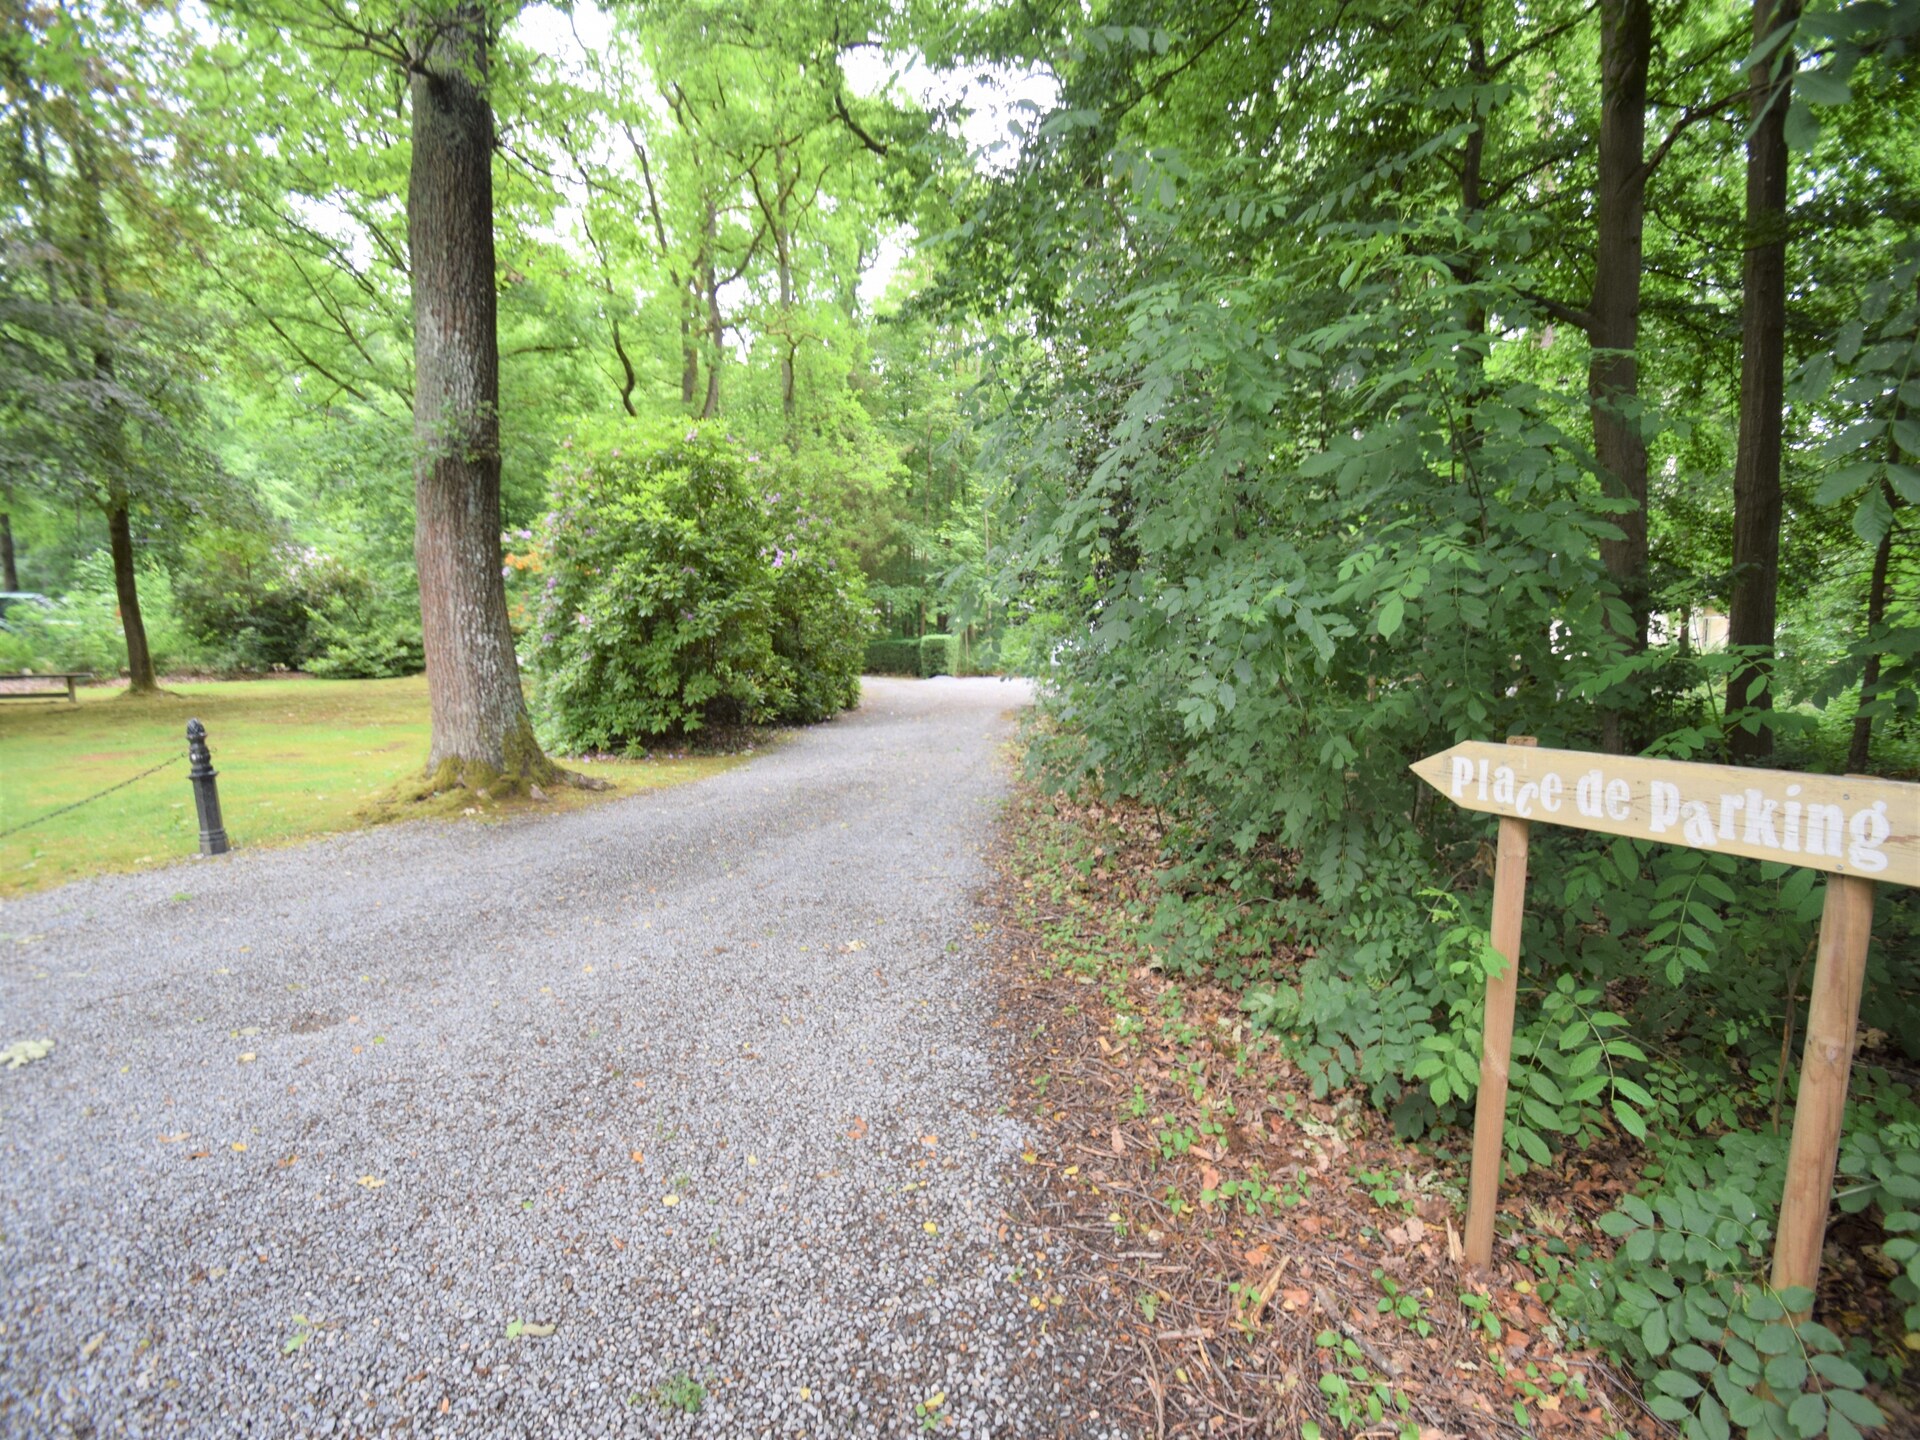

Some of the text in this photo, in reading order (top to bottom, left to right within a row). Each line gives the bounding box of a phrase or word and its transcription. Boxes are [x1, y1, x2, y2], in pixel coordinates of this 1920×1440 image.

[1451, 756, 1891, 872] Place de Parking
